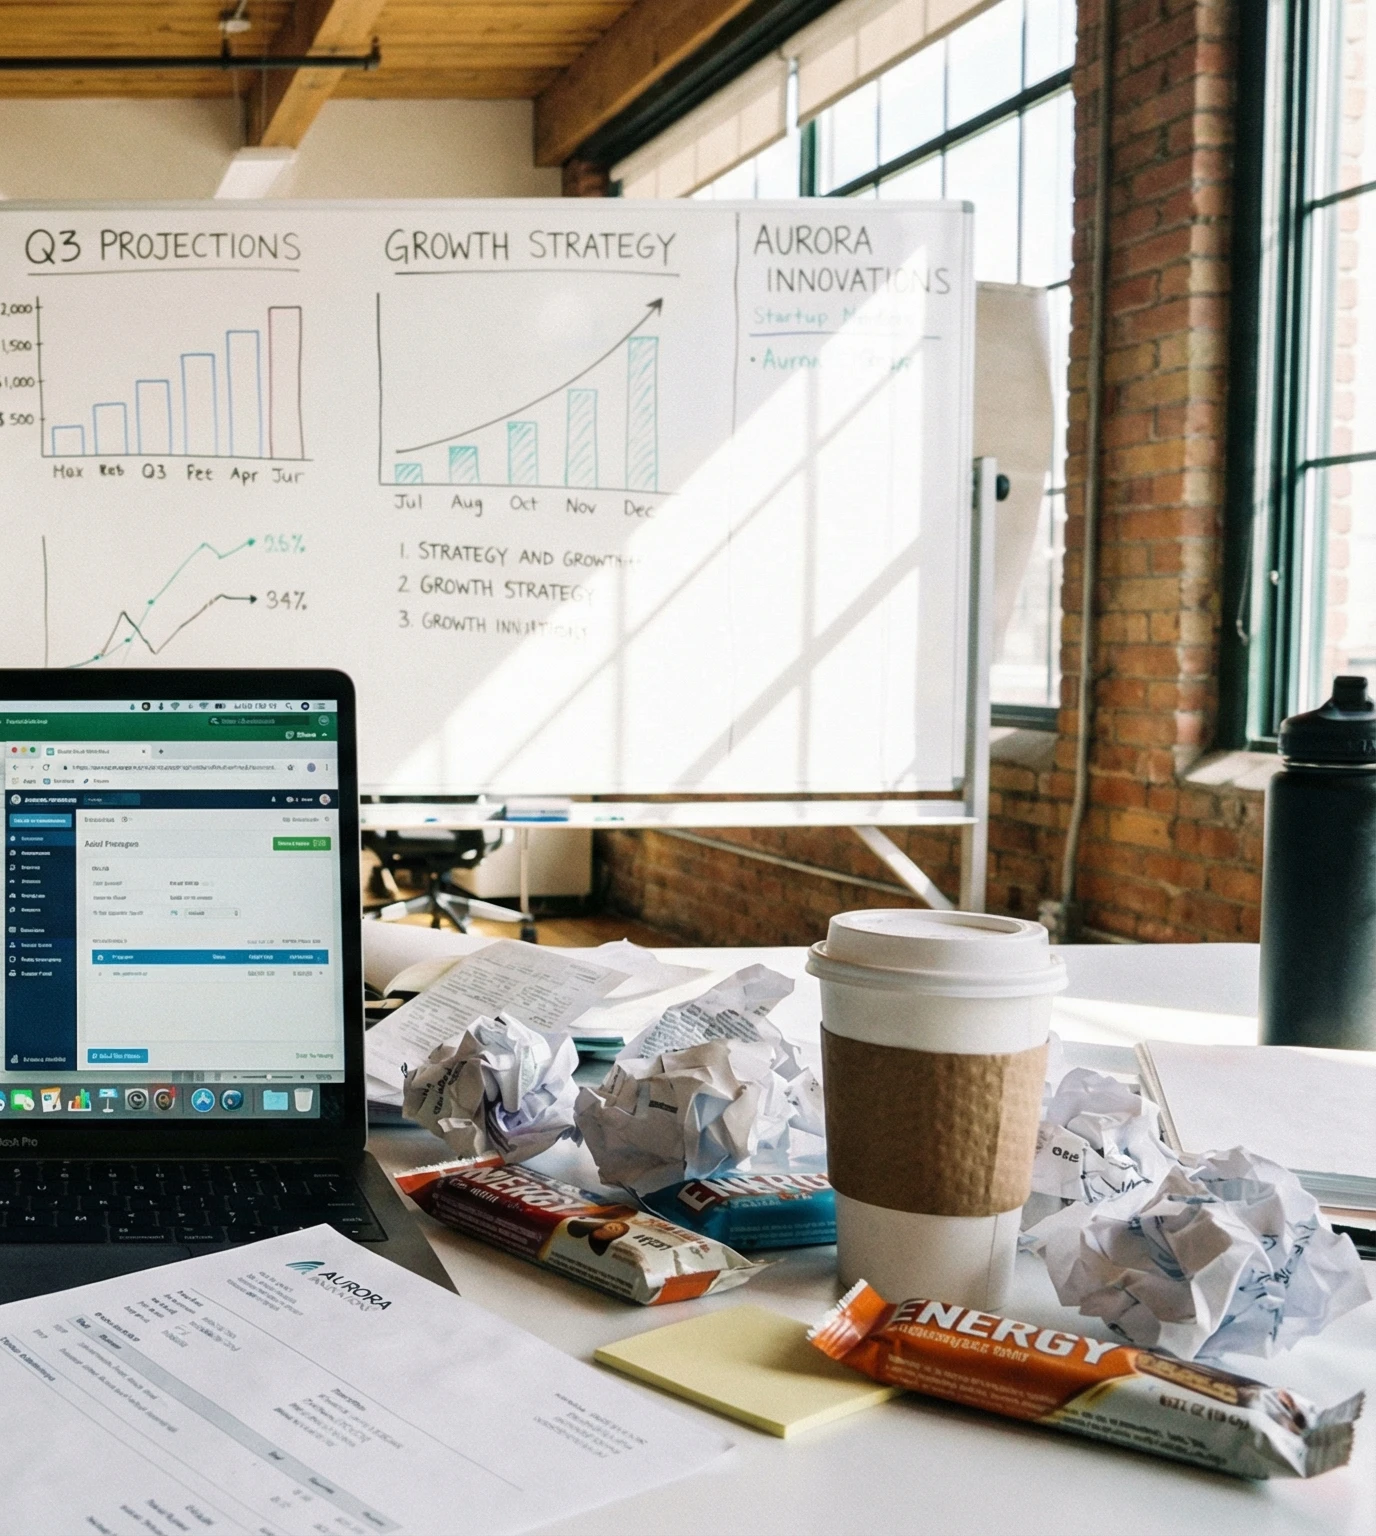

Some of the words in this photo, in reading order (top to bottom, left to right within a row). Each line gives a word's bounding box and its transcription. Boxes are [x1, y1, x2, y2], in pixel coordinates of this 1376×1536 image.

[25, 229, 81, 265] Q3
[100, 229, 301, 261] PROJECTIONS
[385, 228, 509, 264] GROWTH
[528, 230, 677, 266] STRATEGY
[754, 224, 873, 255] AURORA
[767, 267, 951, 295] INNOVATIONS
[754, 307, 829, 327] Startup
[230, 466, 259, 487] Apr
[394, 493, 423, 512] Jul
[450, 494, 483, 517] Aug
[510, 495, 539, 513] Oct
[566, 497, 598, 516] Nov
[624, 498, 655, 518] Dec
[418, 541, 508, 567] STRATEGY
[519, 550, 554, 567] AND
[421, 575, 493, 597] GROWTH
[267, 590, 307, 610] 34%
[422, 612, 486, 633] GROWTH
[318, 1271, 392, 1310] AURORA
[892, 1299, 1121, 1364] ENERGY
